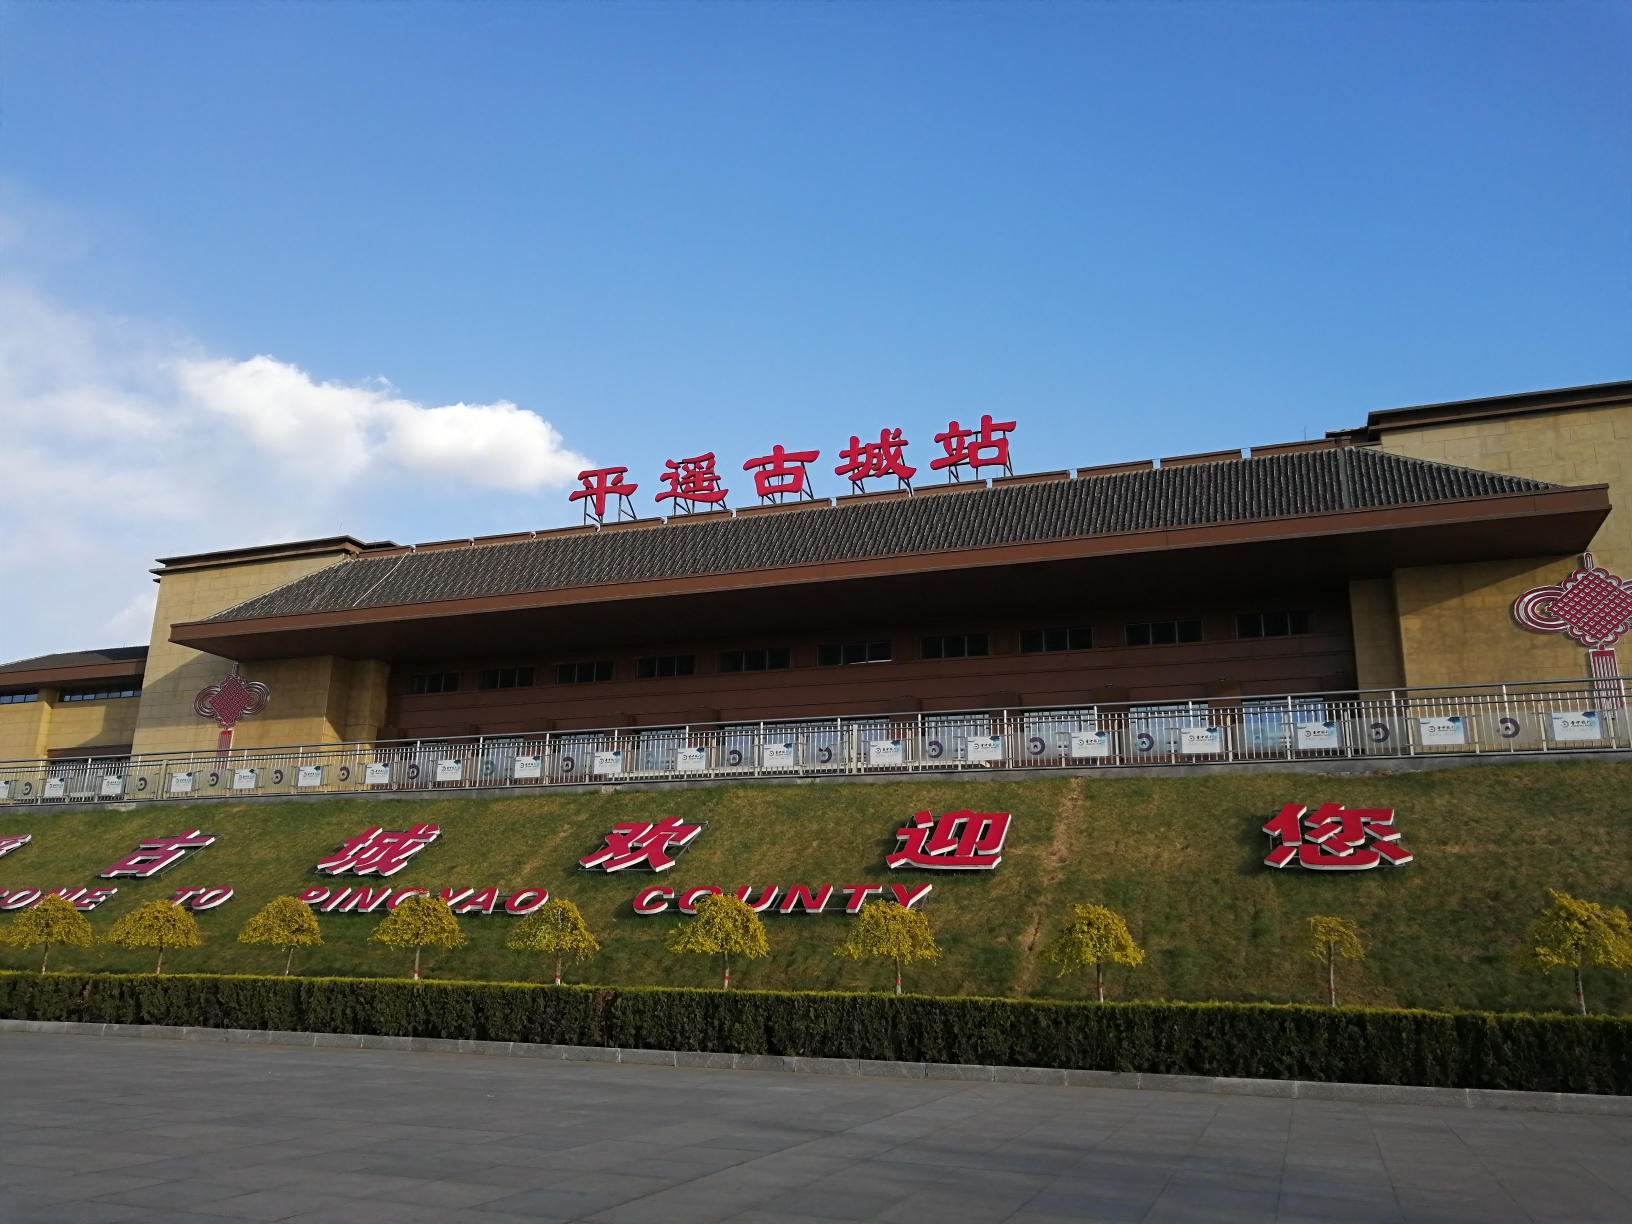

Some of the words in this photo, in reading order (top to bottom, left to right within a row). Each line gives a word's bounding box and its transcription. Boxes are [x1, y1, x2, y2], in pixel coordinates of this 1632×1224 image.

[567, 415, 1017, 517] 平遥古城站
[171, 885, 234, 910] TO
